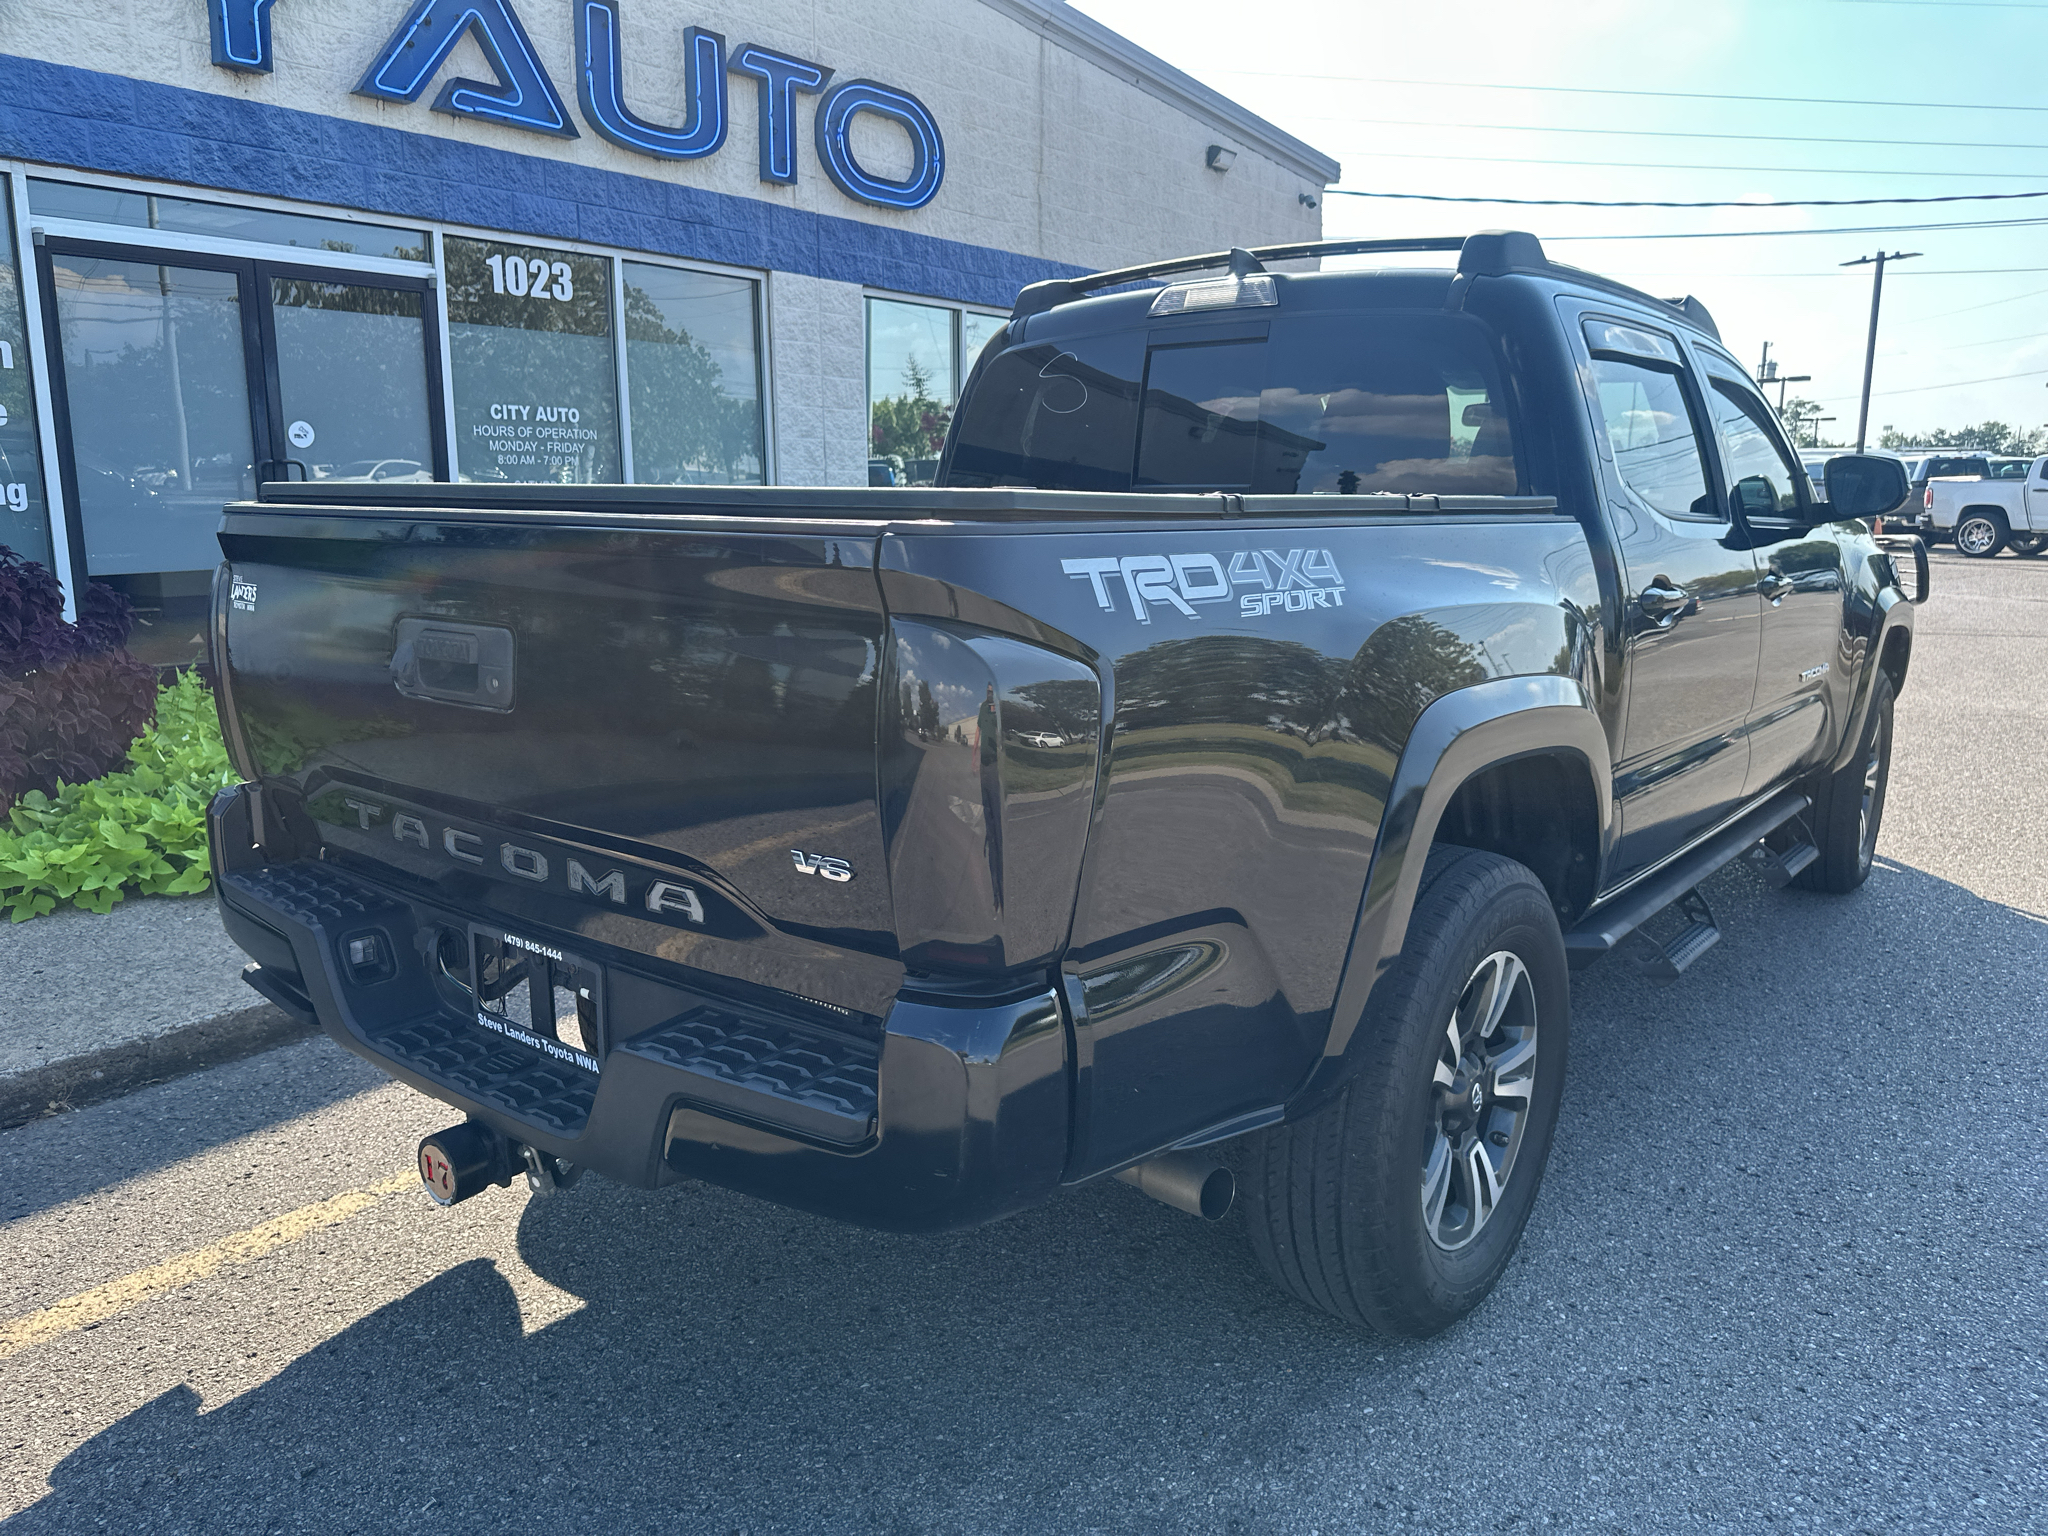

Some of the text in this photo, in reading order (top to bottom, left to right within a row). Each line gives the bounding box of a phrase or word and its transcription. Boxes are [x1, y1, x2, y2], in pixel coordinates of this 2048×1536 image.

[351, 0, 946, 212] AUTO
[485, 253, 574, 302] 1023
[490, 404, 580, 423] CITY AUTO
[473, 425, 598, 440] HOURS OF OPERATION
[489, 440, 538, 452] MONDAY
[547, 442, 586, 454] FRIDAY
[497, 454, 518, 465] 8:00
[520, 455, 535, 465] AM
[543, 455, 563, 466] 7:00
[565, 456, 579, 466] PM
[1060, 552, 1235, 625] TRD
[1240, 585, 1346, 618] SPORT
[344, 797, 705, 924] TACOMA
[790, 849, 858, 883] V6
[504, 933, 563, 962] (479) 845-1444
[477, 1012, 600, 1074] Steve Landers Toyota NWA
[424, 1153, 449, 1191] 17
